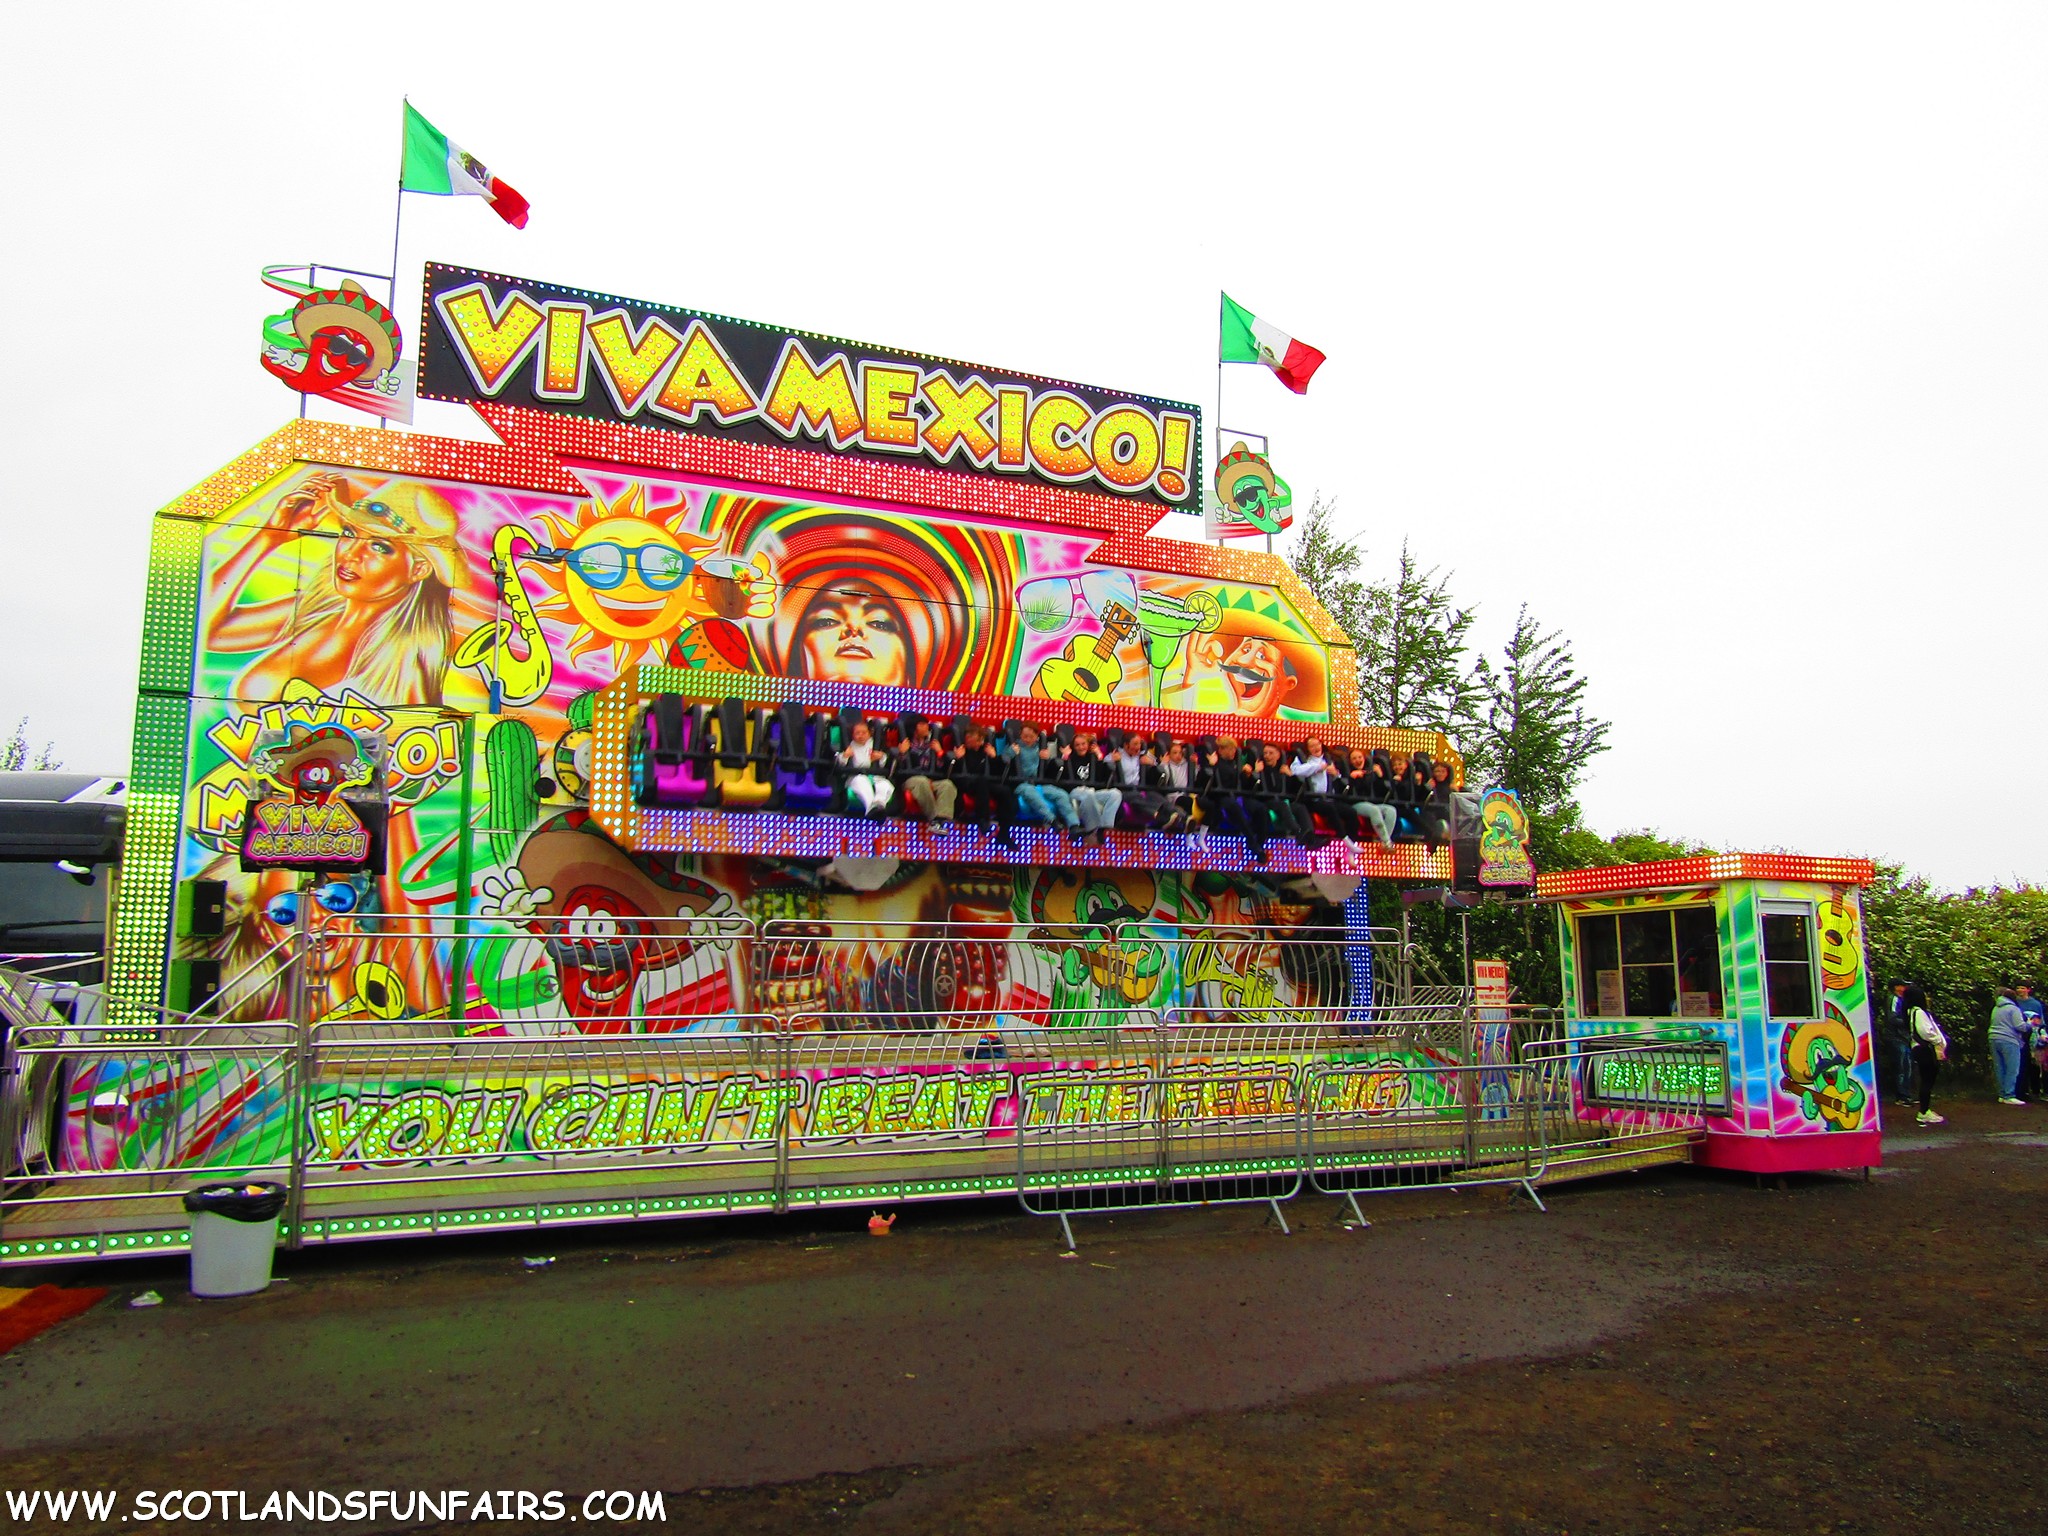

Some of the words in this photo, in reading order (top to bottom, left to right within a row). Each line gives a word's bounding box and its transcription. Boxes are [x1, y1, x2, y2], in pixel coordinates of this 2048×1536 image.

[434, 283, 764, 418] VIVA
[757, 337, 1195, 501] MEXICO!
[260, 803, 359, 834] VIVA
[251, 832, 366, 858] MEXICO!
[1483, 846, 1529, 867] VIVA
[1602, 1059, 1651, 1089] PAY
[1653, 1062, 1723, 1094] HERE
[303, 1086, 526, 1171] YOU
[525, 1075, 808, 1160] CAN'T
[802, 1070, 1012, 1147] BEAT
[1017, 1065, 1152, 1136] THE
[1156, 1059, 1412, 1129] FEELING
